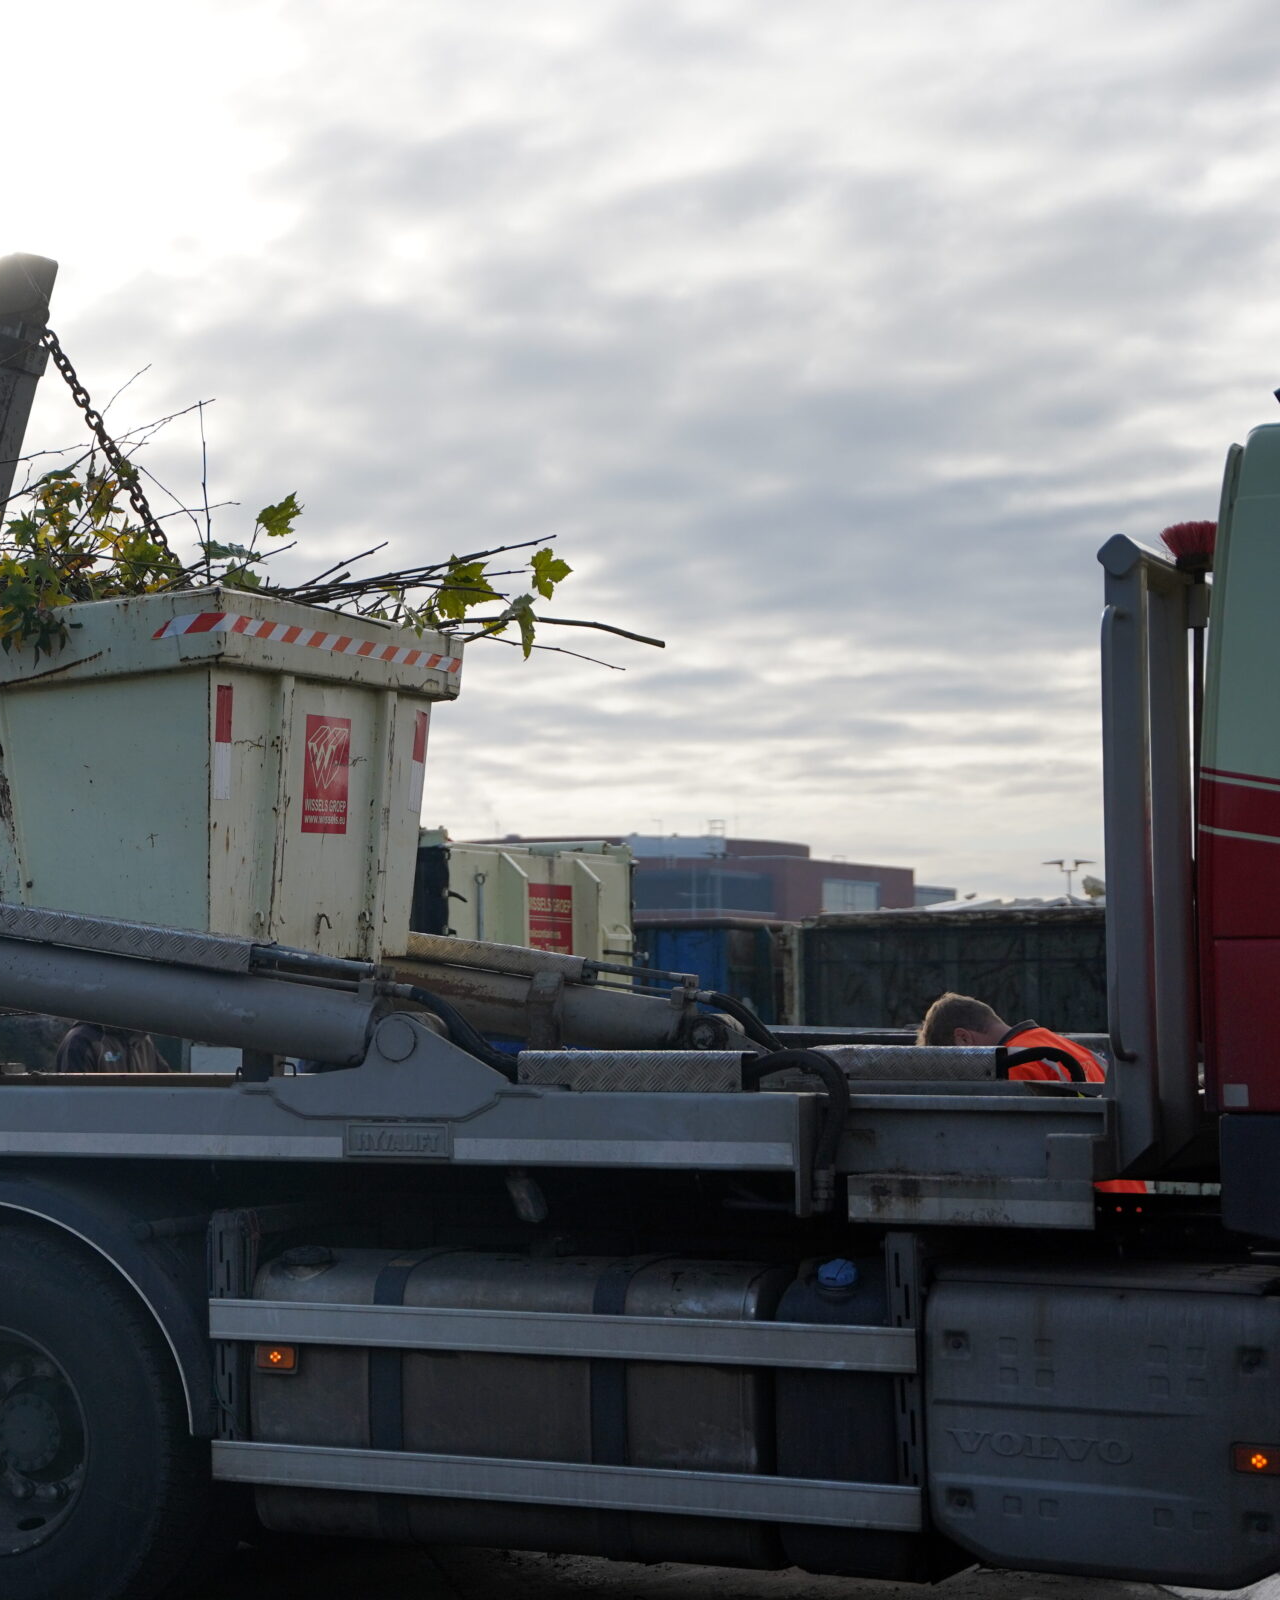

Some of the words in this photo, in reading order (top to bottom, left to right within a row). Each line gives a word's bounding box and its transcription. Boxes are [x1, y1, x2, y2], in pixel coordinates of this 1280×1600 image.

[305, 799, 328, 812] WISSELS
[329, 800, 347, 813] GROEP
[946, 1428, 1135, 1466] VOLVO
